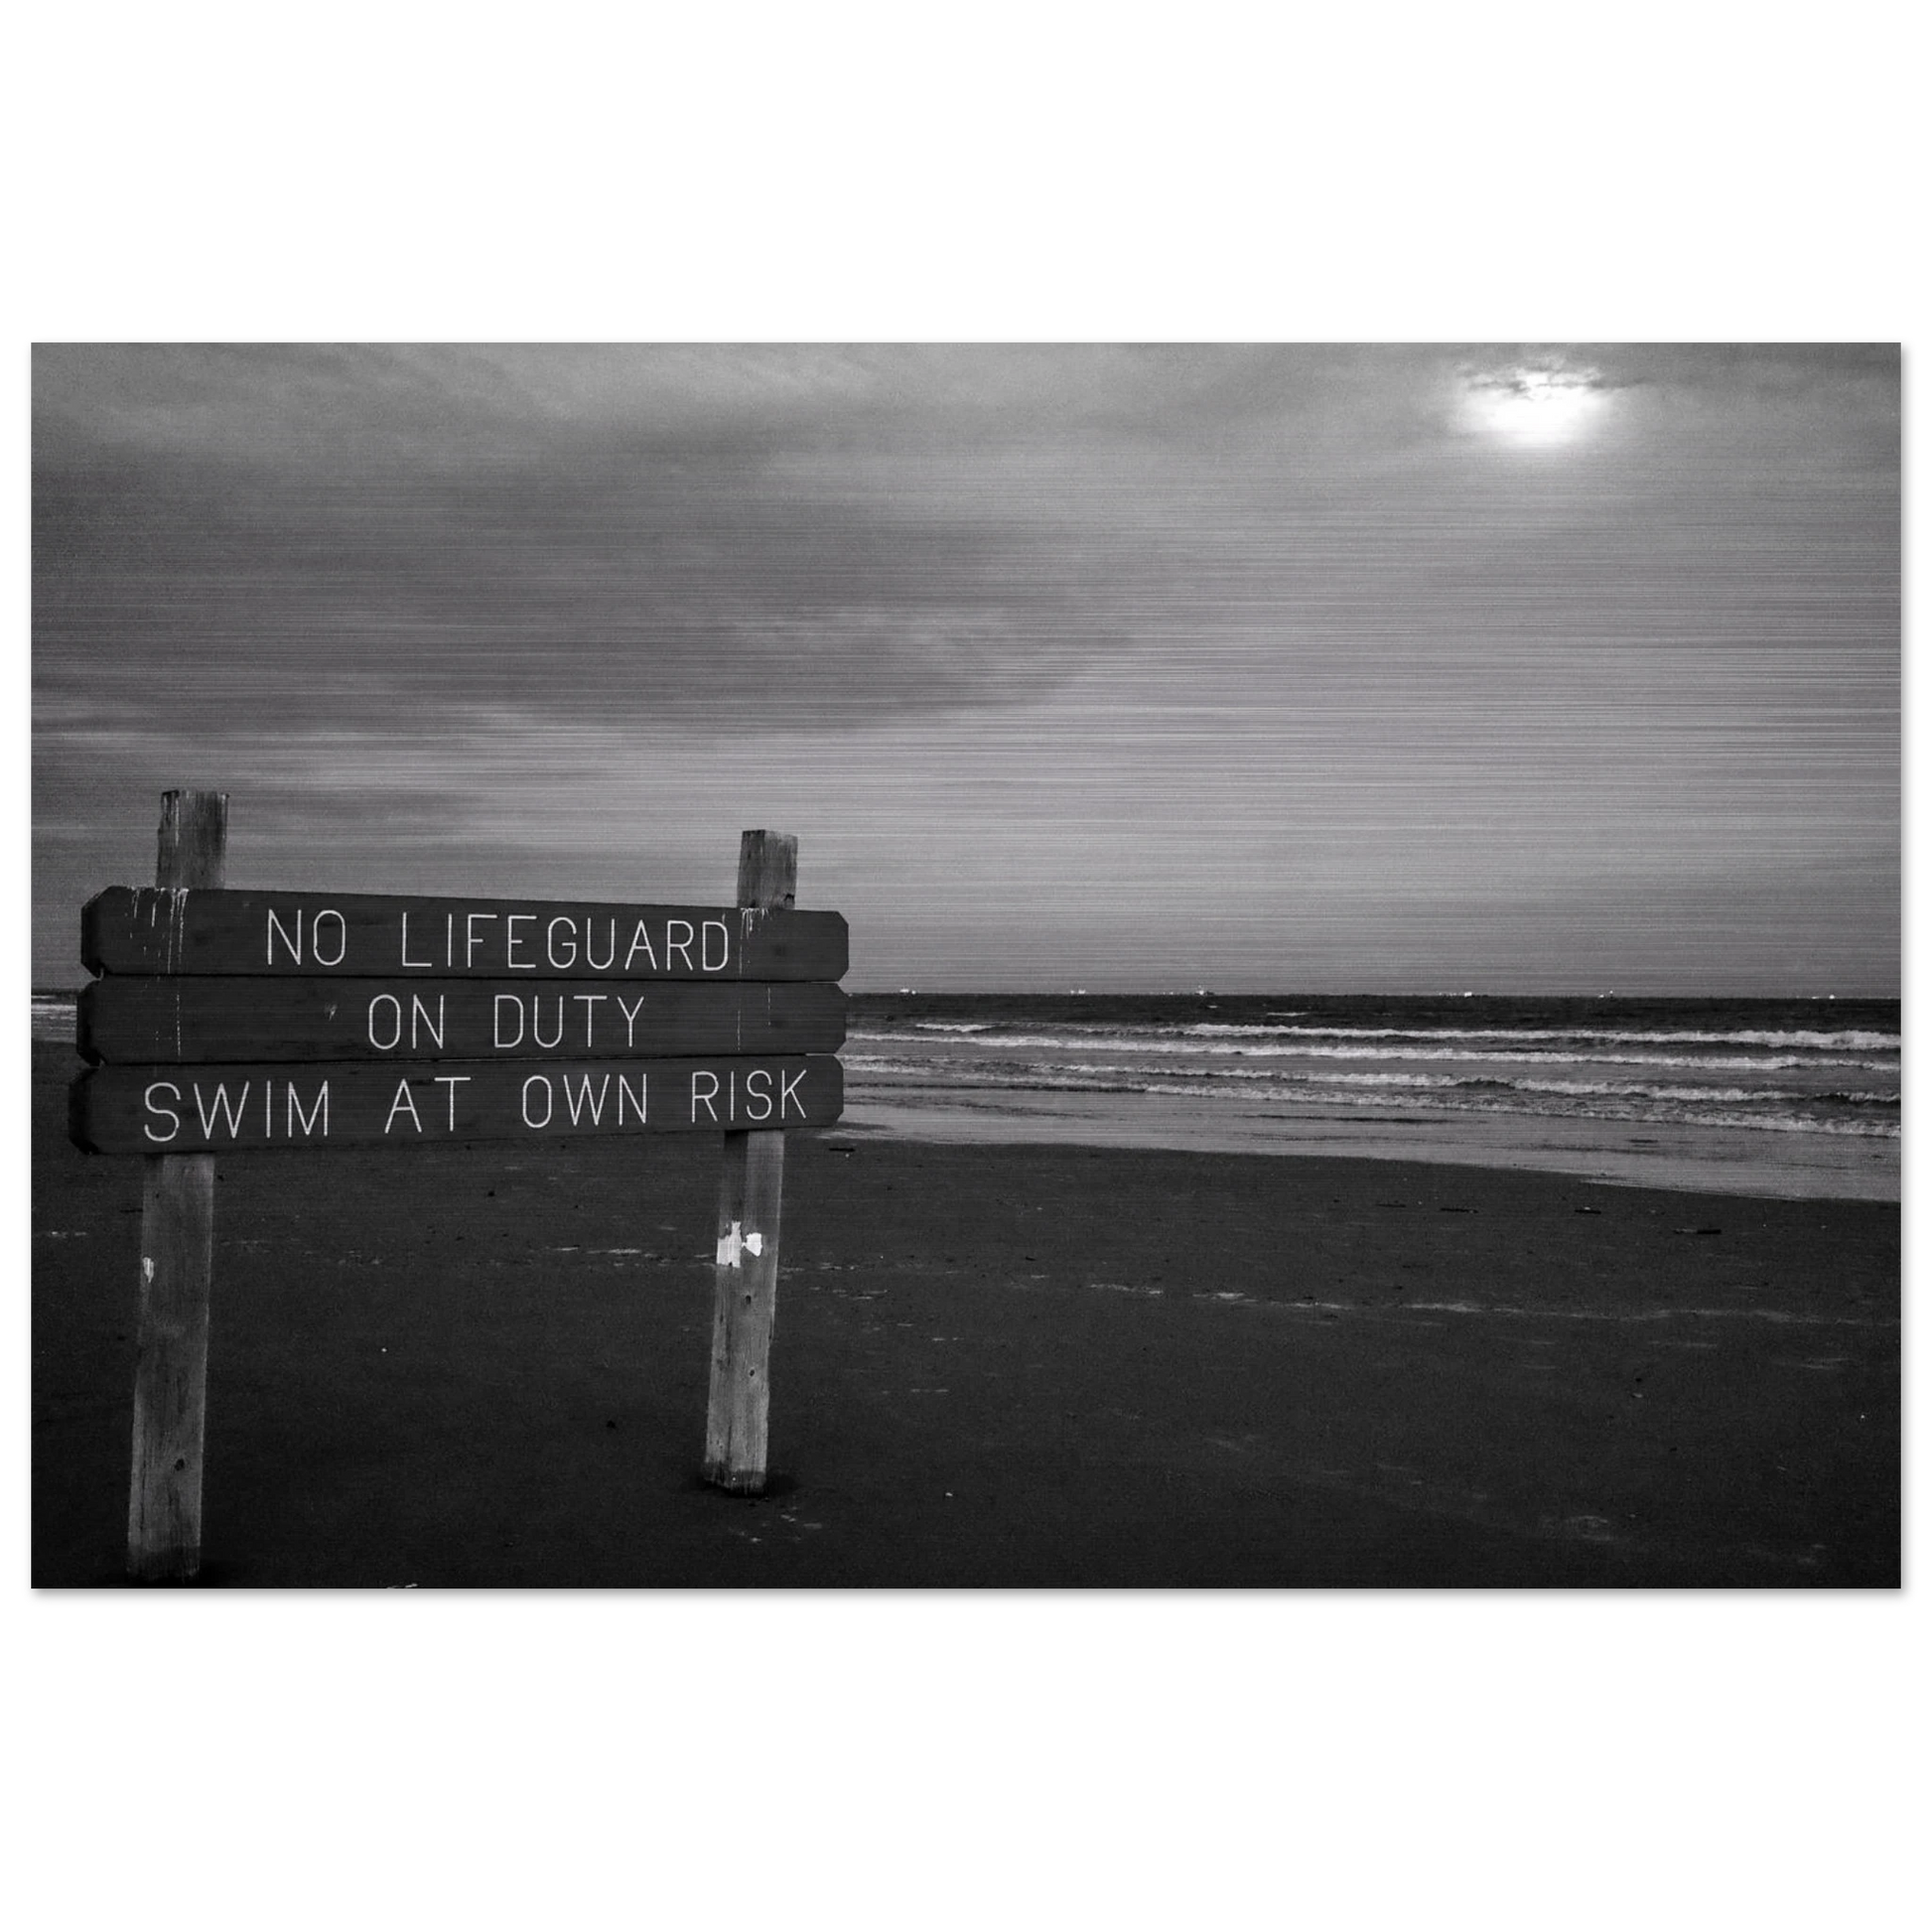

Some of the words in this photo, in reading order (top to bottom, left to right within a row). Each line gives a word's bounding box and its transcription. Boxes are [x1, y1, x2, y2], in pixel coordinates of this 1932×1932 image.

[267, 908, 345, 966] NO
[402, 911, 729, 972] LIFEGUARD
[368, 994, 444, 1049] ON
[494, 995, 644, 1048] DUTY
[144, 1080, 329, 1142] SWIM
[384, 1077, 471, 1134] AT
[522, 1073, 646, 1128] OWN
[691, 1069, 807, 1123] RISK
